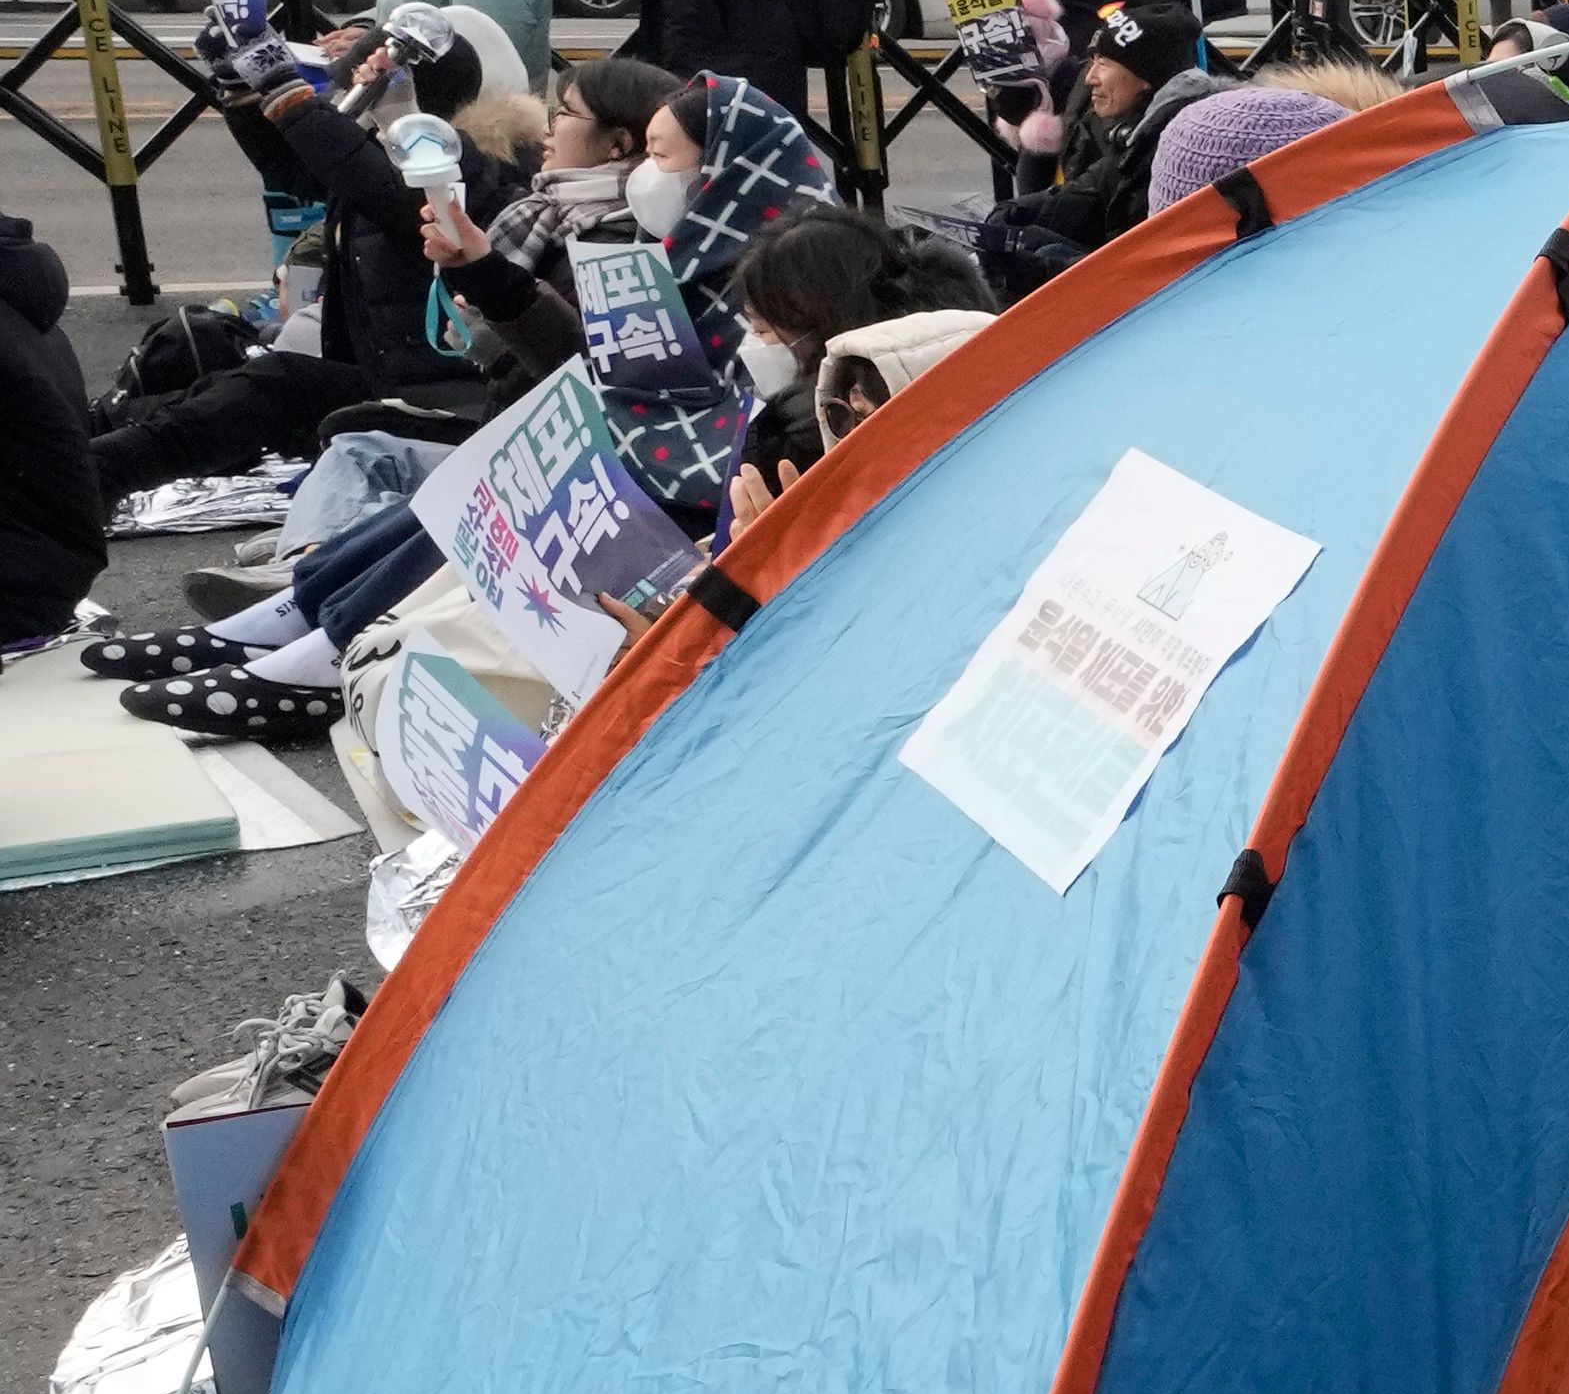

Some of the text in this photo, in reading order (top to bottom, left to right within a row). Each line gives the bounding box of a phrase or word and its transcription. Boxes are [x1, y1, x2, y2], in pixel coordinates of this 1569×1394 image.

[958, 9, 1025, 57] 구속!
[102, 77, 127, 154] LINE
[577, 254, 661, 316] 체포!
[586, 309, 683, 373] 구속!
[489, 377, 593, 531] 체포!
[453, 478, 497, 572] 내란수괴
[533, 455, 630, 596] 구속!
[1014, 596, 1193, 738] 윤석열 체포를 위한
